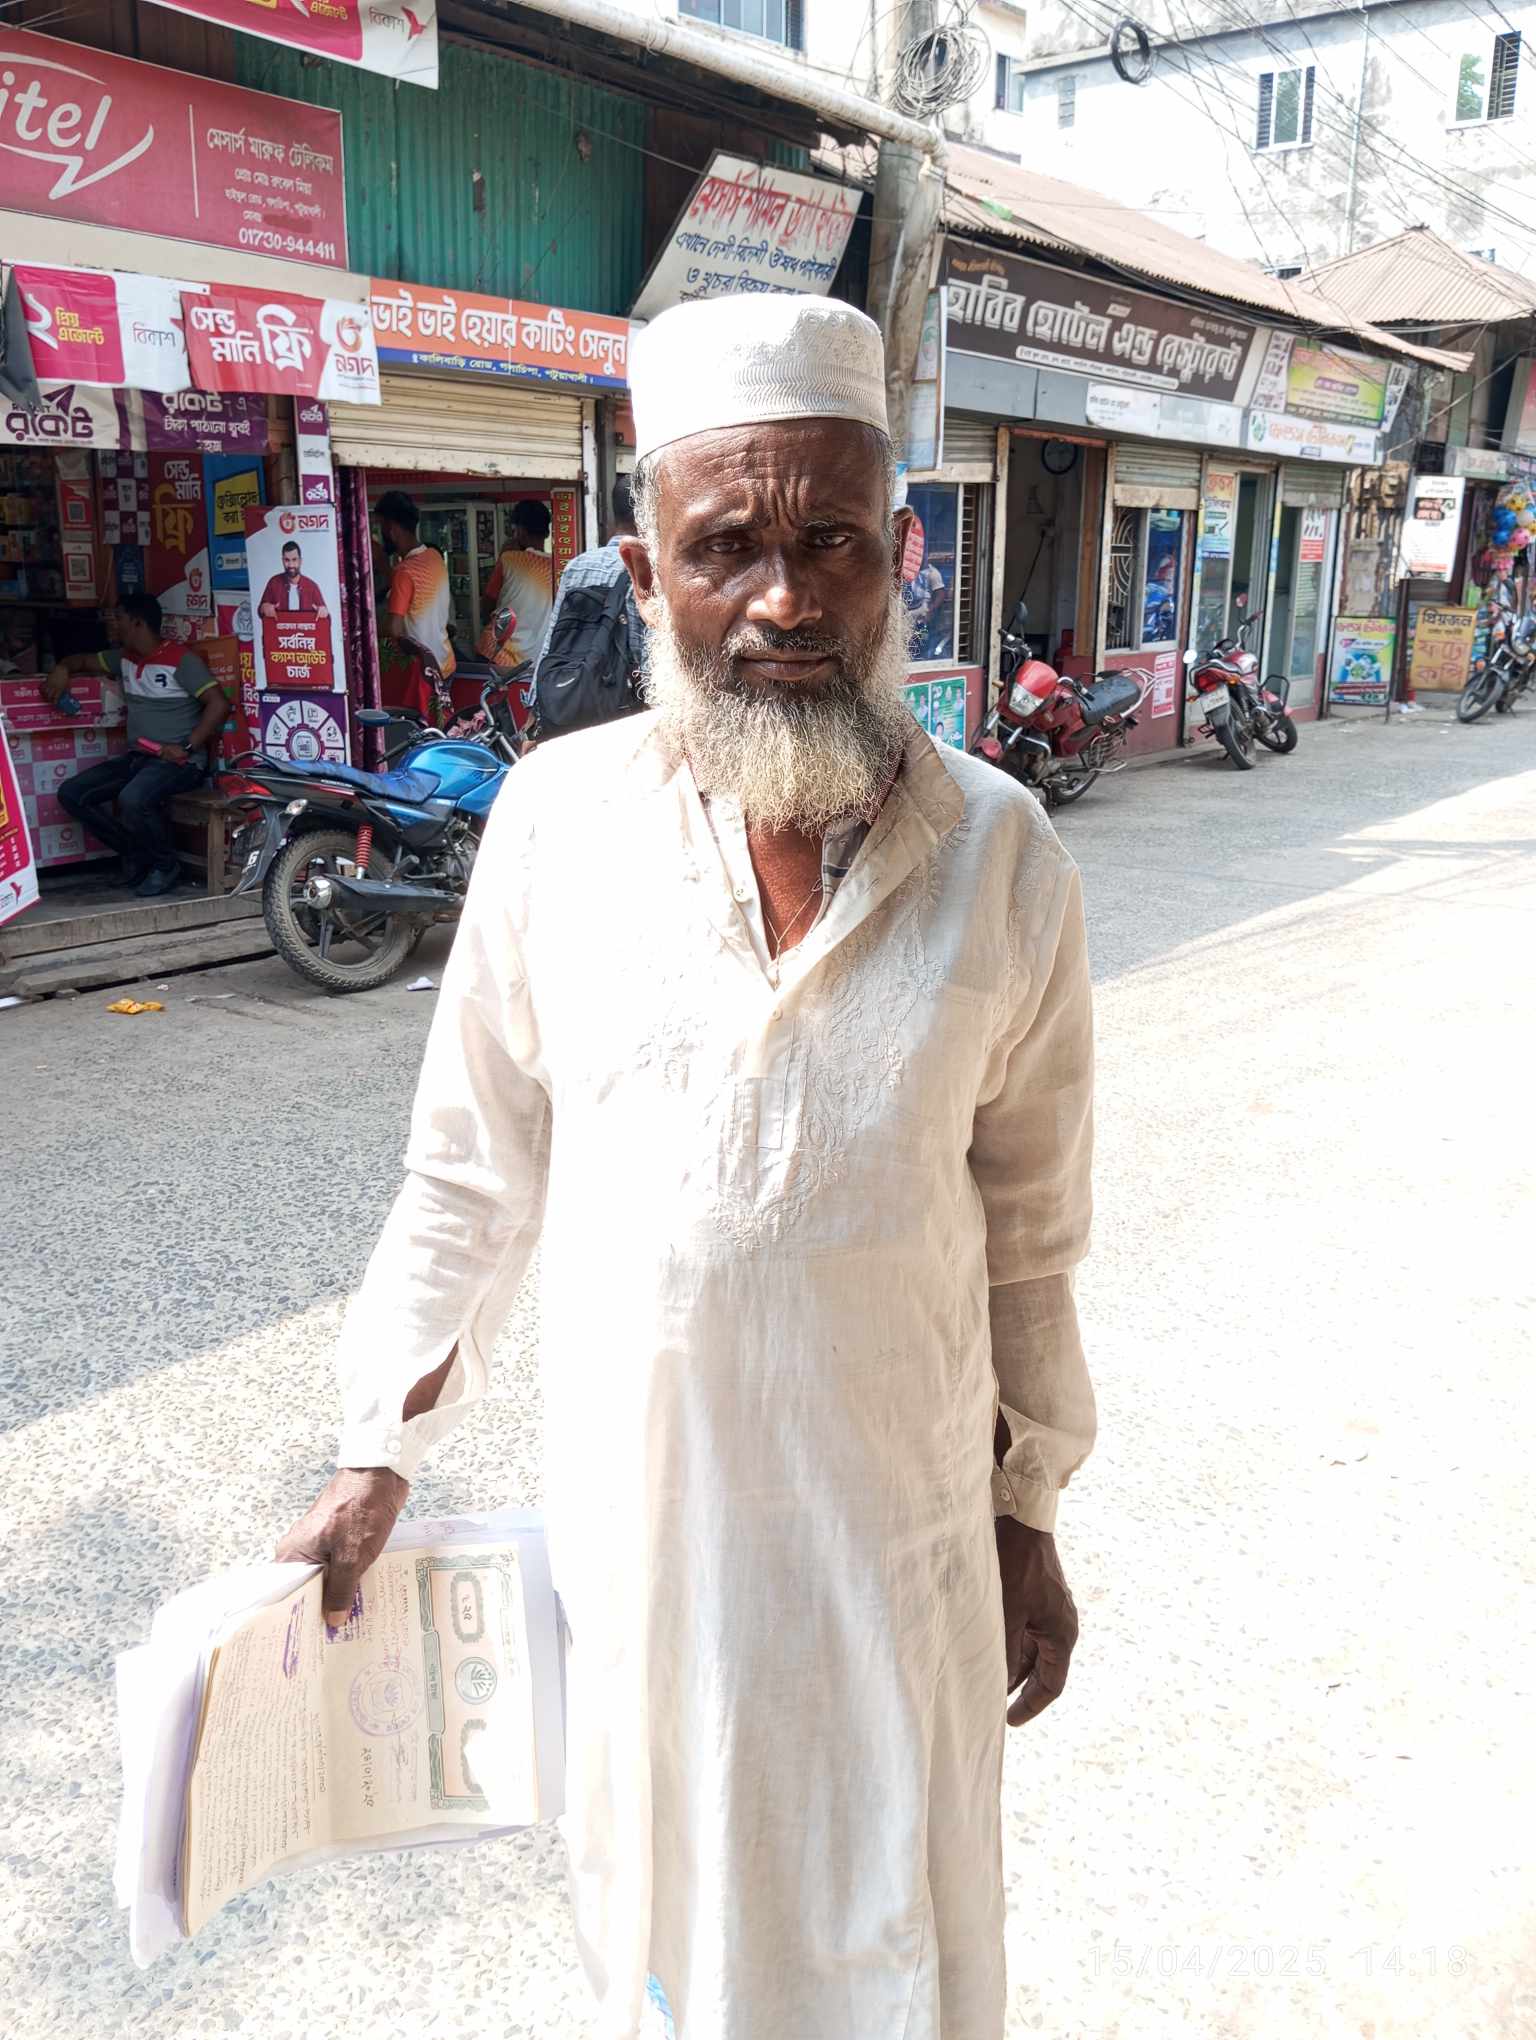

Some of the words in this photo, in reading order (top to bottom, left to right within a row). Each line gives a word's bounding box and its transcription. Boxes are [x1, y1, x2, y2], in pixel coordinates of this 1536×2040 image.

[207, 127, 246, 155] মেসার্স
[289, 141, 333, 176] টেলিকম
[239, 228, 336, 260] 01730-944411
[370, 288, 414, 338] ভাই
[416, 295, 457, 343] ভাই
[461, 308, 519, 349] হেয়ার
[521, 306, 576, 358] কাটিং
[579, 327, 628, 376] সেলুন
[946, 274, 1027, 333] হাবিব
[1026, 300, 1113, 353] হোটেল
[1112, 322, 1160, 366] এন্ড
[132, 322, 177, 348] বিকাশ
[191, 307, 236, 336] সেন্ড
[256, 304, 314, 373] ফ্রি
[209, 331, 262, 366] মানি
[335, 353, 377, 378] নগদ
[164, 460, 190, 481] সেন্ড
[298, 515, 329, 530] নগদ
[186, 594, 209, 609] নগদ
[278, 633, 316, 651] সর্বনিম্ন
[270, 651, 296, 664] ক্যাশ
[296, 650, 327, 665] আউট
[286, 664, 312, 679] চার্জ
